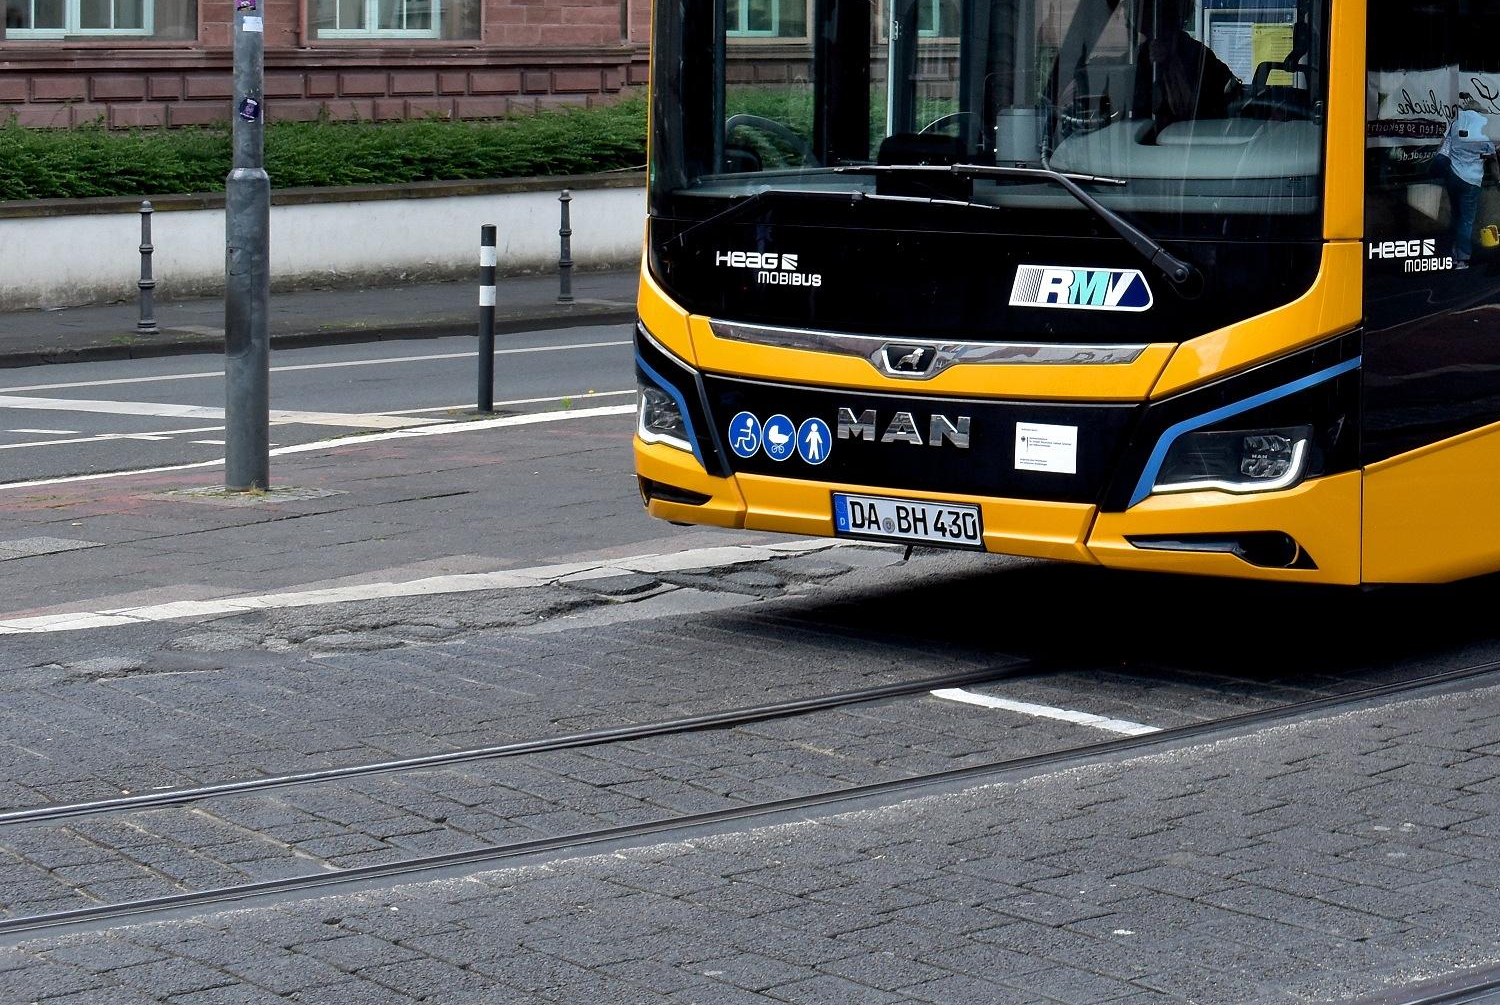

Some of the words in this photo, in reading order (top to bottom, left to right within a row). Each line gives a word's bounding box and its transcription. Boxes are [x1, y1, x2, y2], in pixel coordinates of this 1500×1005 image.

[757, 271, 822, 287] MOBIBUS
[1404, 256, 1453, 273] MOBIBUS
[1036, 268, 1138, 306] RMV
[837, 407, 971, 448] MAN
[849, 501, 881, 531] DA
[896, 505, 929, 536] BH
[933, 510, 978, 541] 430
